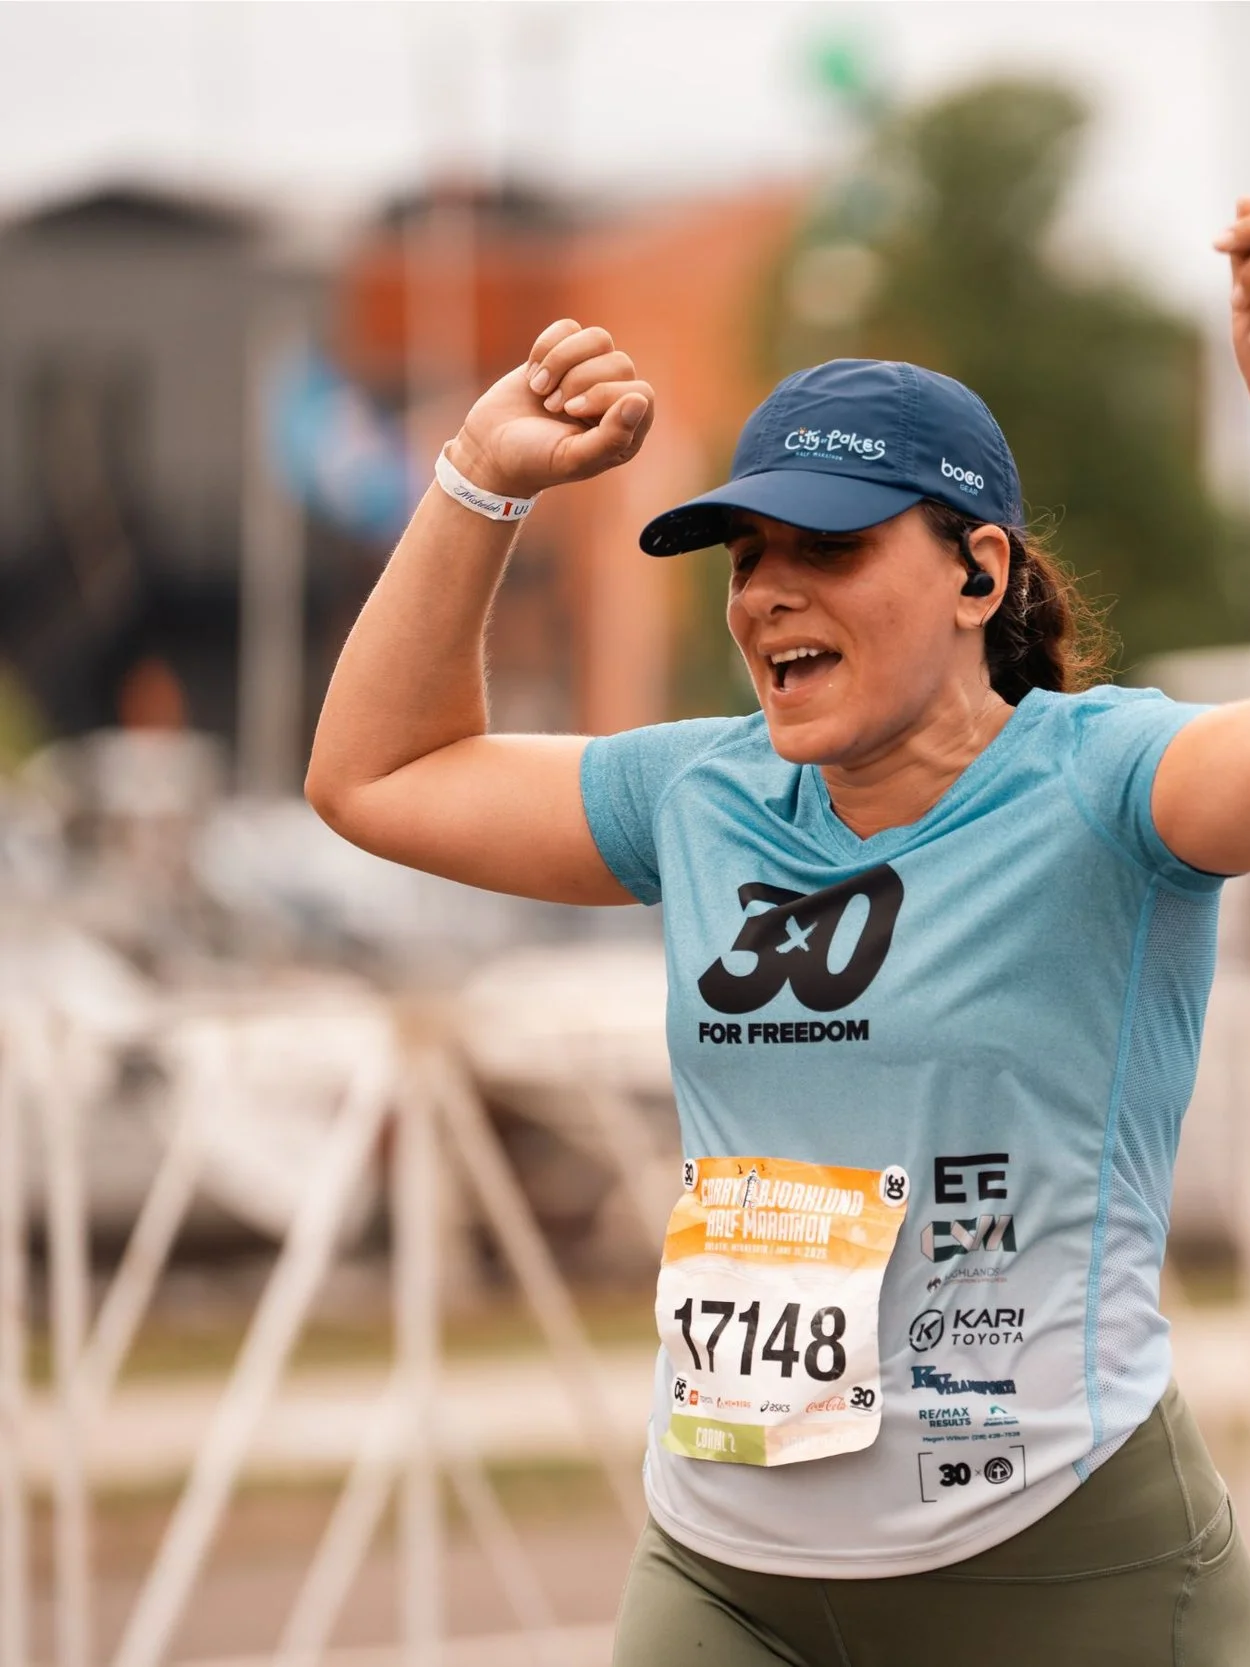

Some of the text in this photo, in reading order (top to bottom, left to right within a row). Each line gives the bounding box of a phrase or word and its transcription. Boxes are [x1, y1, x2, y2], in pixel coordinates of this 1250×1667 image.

[785, 428, 821, 451] City
[699, 1019, 869, 1045] FOR FREEDOM
[886, 1174, 905, 1201] 30
[742, 1210, 832, 1245] MARATHON
[953, 1308, 1025, 1329] KARI
[674, 1298, 847, 1382] 17148
[952, 1332, 1024, 1346] TOYOTA
[850, 1386, 875, 1408] 30
[918, 1407, 970, 1420] RE/MAX
[929, 1417, 972, 1428] RESULTS
[938, 1462, 972, 1487] 30
